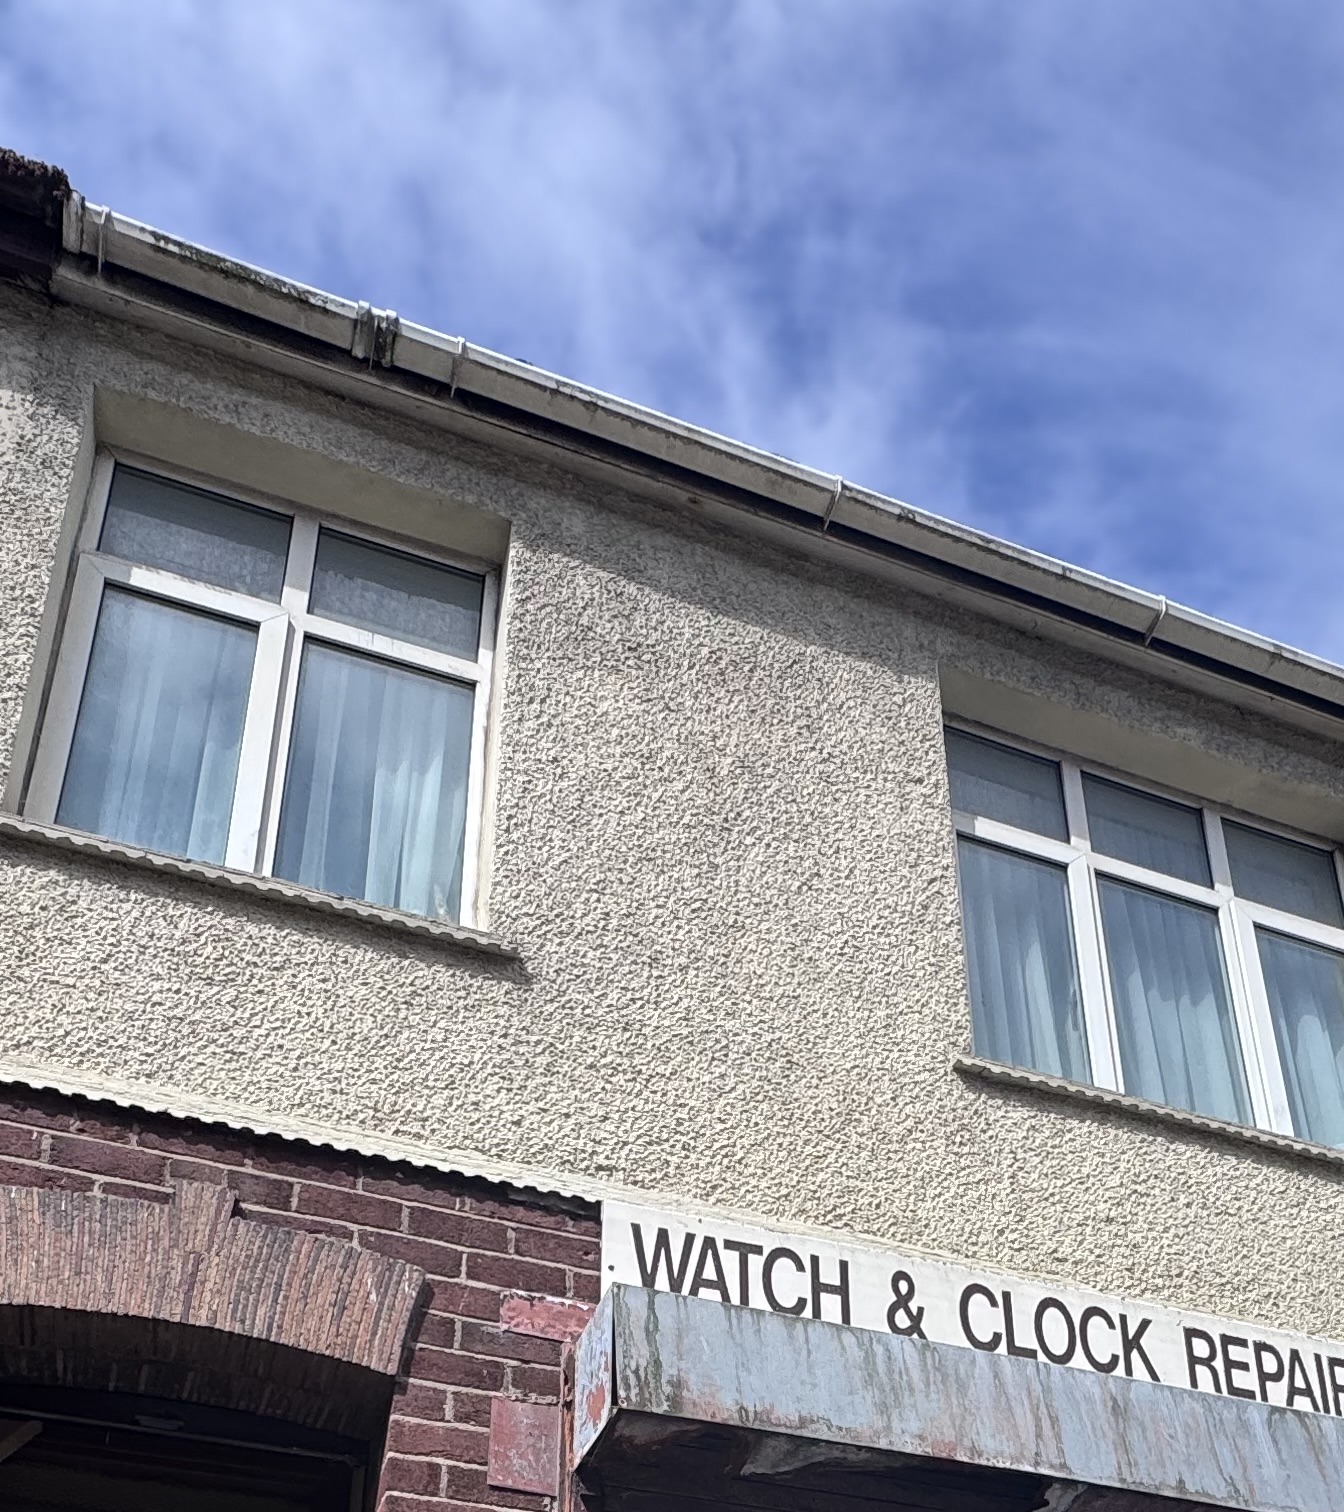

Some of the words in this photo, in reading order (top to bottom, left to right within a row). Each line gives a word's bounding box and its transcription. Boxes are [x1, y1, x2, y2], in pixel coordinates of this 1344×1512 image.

[630, 1222, 852, 1326] WATCH
[886, 1269, 929, 1341] &
[959, 1282, 1162, 1383] CLOCK
